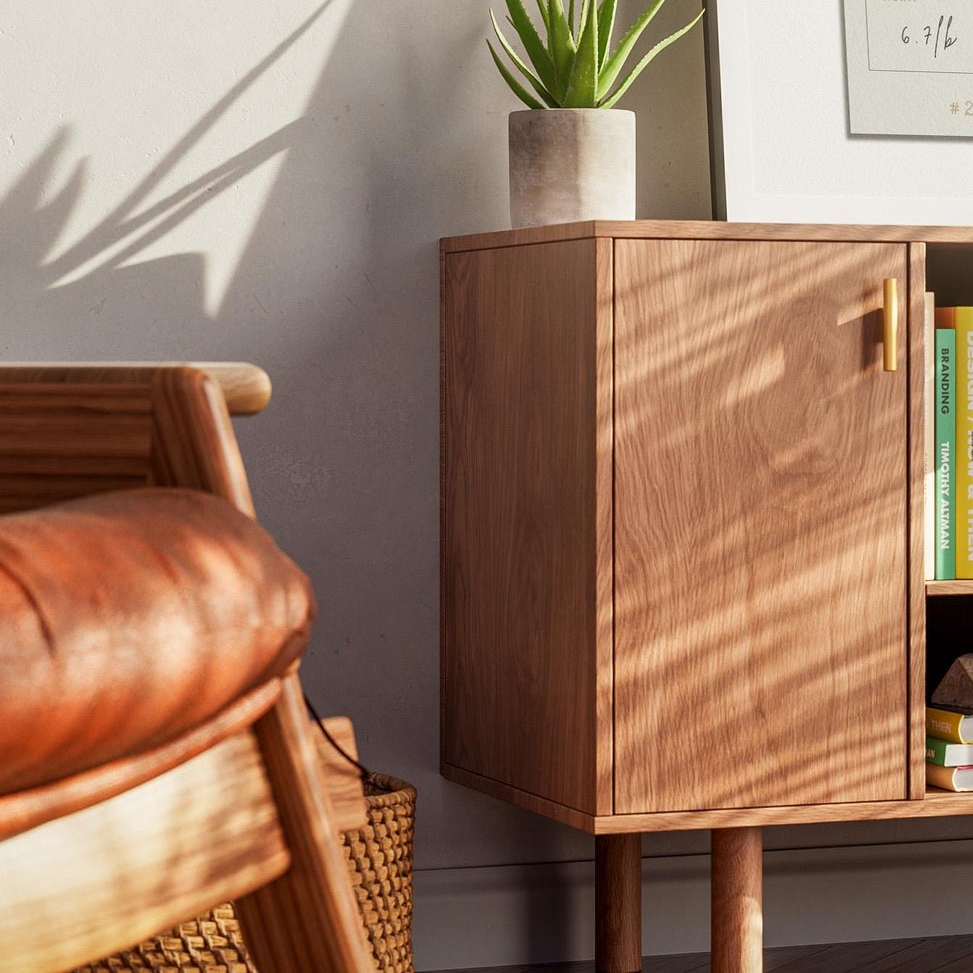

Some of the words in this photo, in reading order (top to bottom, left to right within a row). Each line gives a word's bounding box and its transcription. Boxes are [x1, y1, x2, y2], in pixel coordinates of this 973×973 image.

[941, 348, 950, 415] BRANDING
[940, 441, 950, 496] TIMOTHY
[940, 499, 950, 549] ALTMAN
[931, 719, 952, 734] THEN
